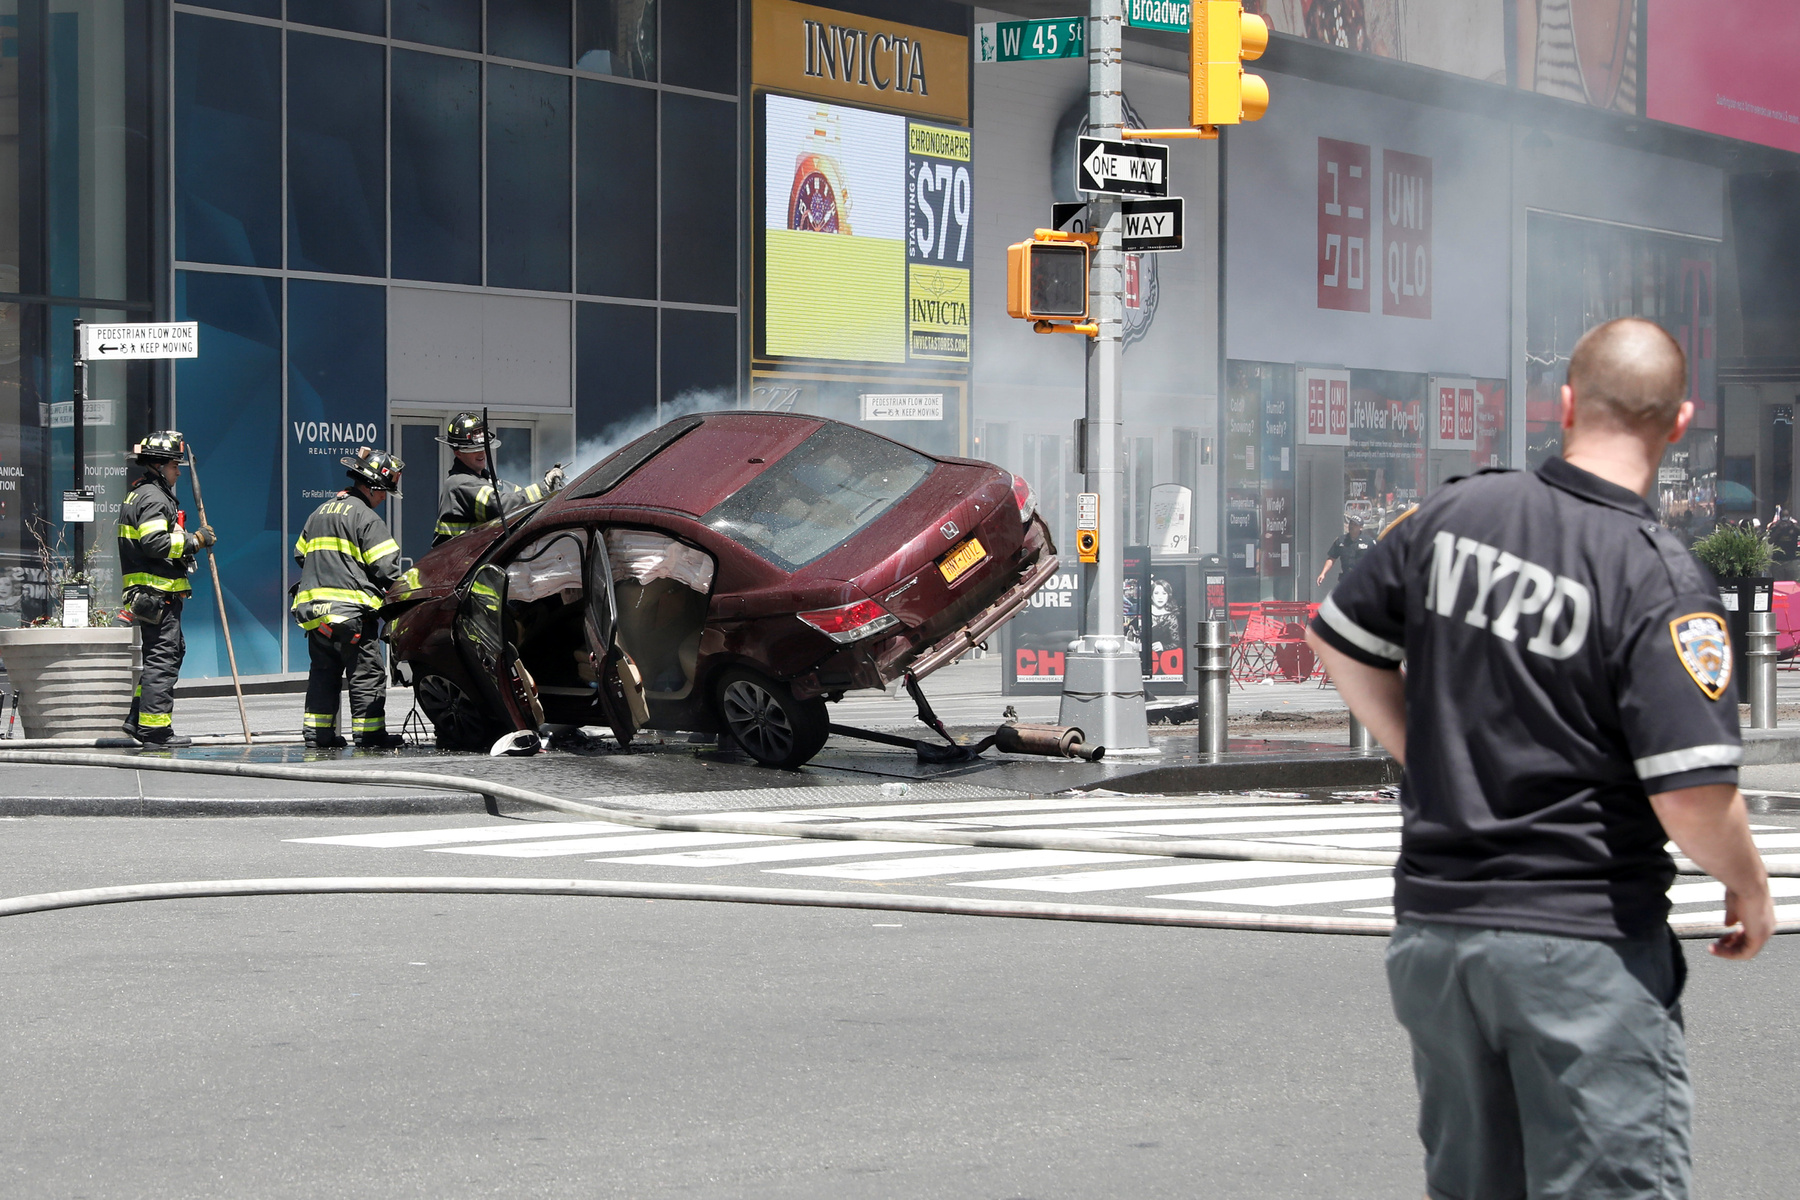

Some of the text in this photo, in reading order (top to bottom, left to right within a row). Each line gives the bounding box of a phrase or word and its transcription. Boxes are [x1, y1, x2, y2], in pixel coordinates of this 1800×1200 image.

[1133, 0, 1190, 26] Broadwa
[1002, 23, 1082, 56] W 45 St
[803, 19, 928, 96] INVICTA
[911, 128, 969, 158] CHRONOGRAPHS
[909, 159, 916, 180] AT
[1093, 156, 1156, 181] ONE WAY
[1388, 171, 1423, 231] UNI
[917, 161, 971, 263] $79
[1126, 215, 1166, 236] WAY
[1388, 241, 1427, 305] QLO
[912, 298, 968, 326] INVICTA
[97, 327, 193, 340] PEDESTRIAN FLOW ZONE
[913, 335, 968, 352] INVICTASTORES.COM
[140, 342, 193, 353] KEEP MOVING
[871, 397, 939, 407] PEDESTRIAN FLOW ZONE
[1331, 387, 1345, 406] UNI
[1459, 395, 1472, 412] UNI
[901, 408, 940, 417] KEEP MOVING
[1331, 409, 1346, 431] QLO
[1391, 403, 1425, 438] Pop-Up
[294, 421, 377, 444] VORNADO
[1459, 416, 1473, 436] QLO
[308, 447, 360, 455] REALTY TRUS
[84, 463, 129, 478] hour power
[302, 489, 311, 498] For
[311, 489, 324, 498] Retail
[109, 503, 122, 513] scr
[1206, 585, 1225, 596] SURE
[1425, 530, 1592, 660] NYPD
